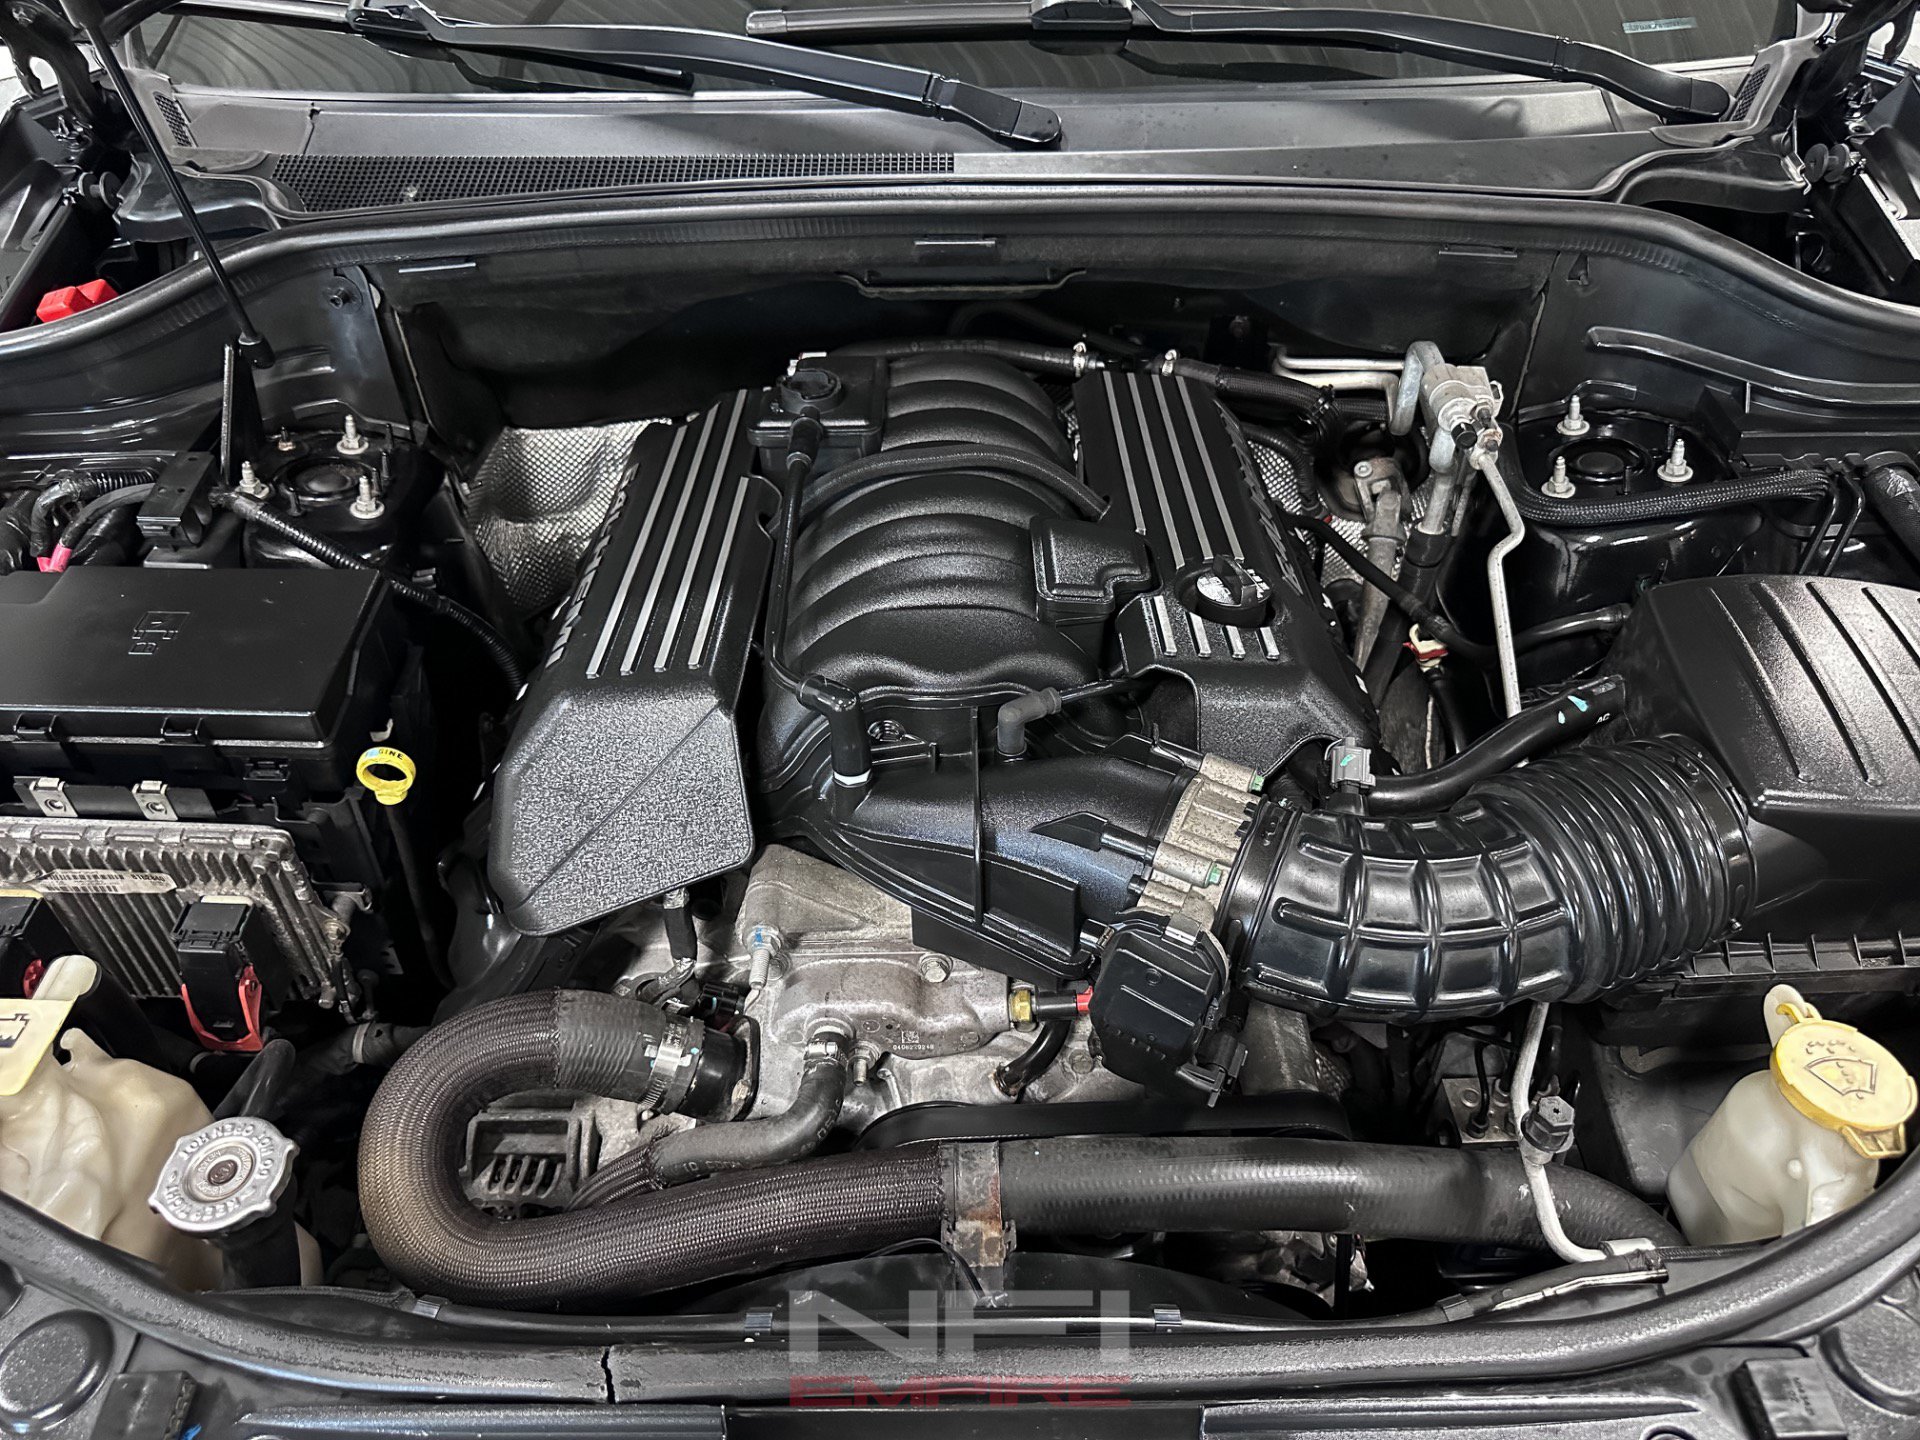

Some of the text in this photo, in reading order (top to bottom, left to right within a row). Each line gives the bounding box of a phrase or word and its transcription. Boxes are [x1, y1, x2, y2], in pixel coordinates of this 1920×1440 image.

[545, 535, 611, 669] HEMI
[365, 748, 404, 761] GINE
[211, 1122, 255, 1139] OPEN
[178, 1132, 211, 1162] HOT
[251, 1131, 275, 1157] NOT
[163, 1184, 193, 1220] TIGHT
[189, 1196, 243, 1222] KEEP
